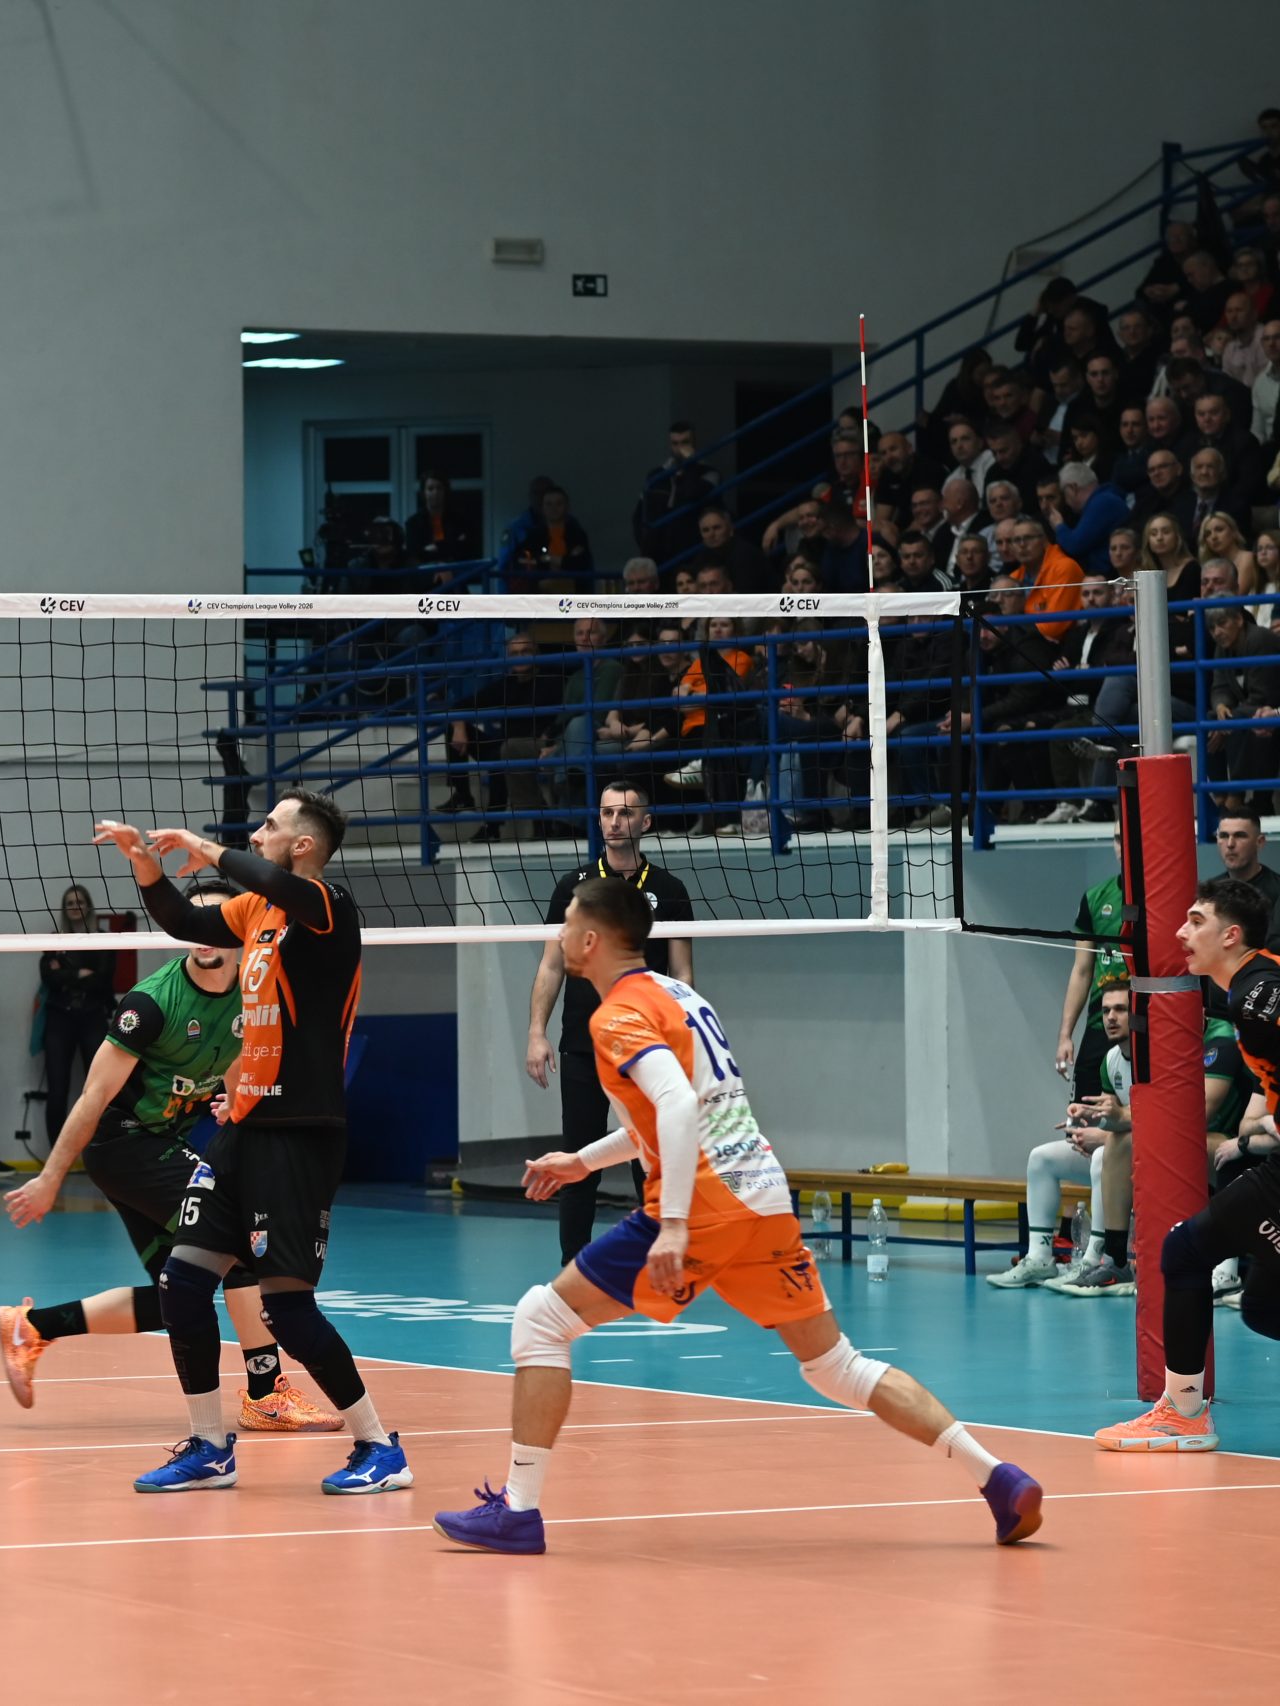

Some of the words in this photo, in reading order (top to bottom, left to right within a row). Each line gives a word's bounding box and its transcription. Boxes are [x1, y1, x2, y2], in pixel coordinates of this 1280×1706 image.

[59, 600, 85, 612] CEV
[436, 601, 460, 612] CEV
[590, 602, 622, 610] Champions
[624, 602, 645, 610] League
[797, 599, 820, 610] CEV
[242, 947, 272, 992] 15
[684, 1006, 742, 1082] 19
[178, 1197, 202, 1227] 15
